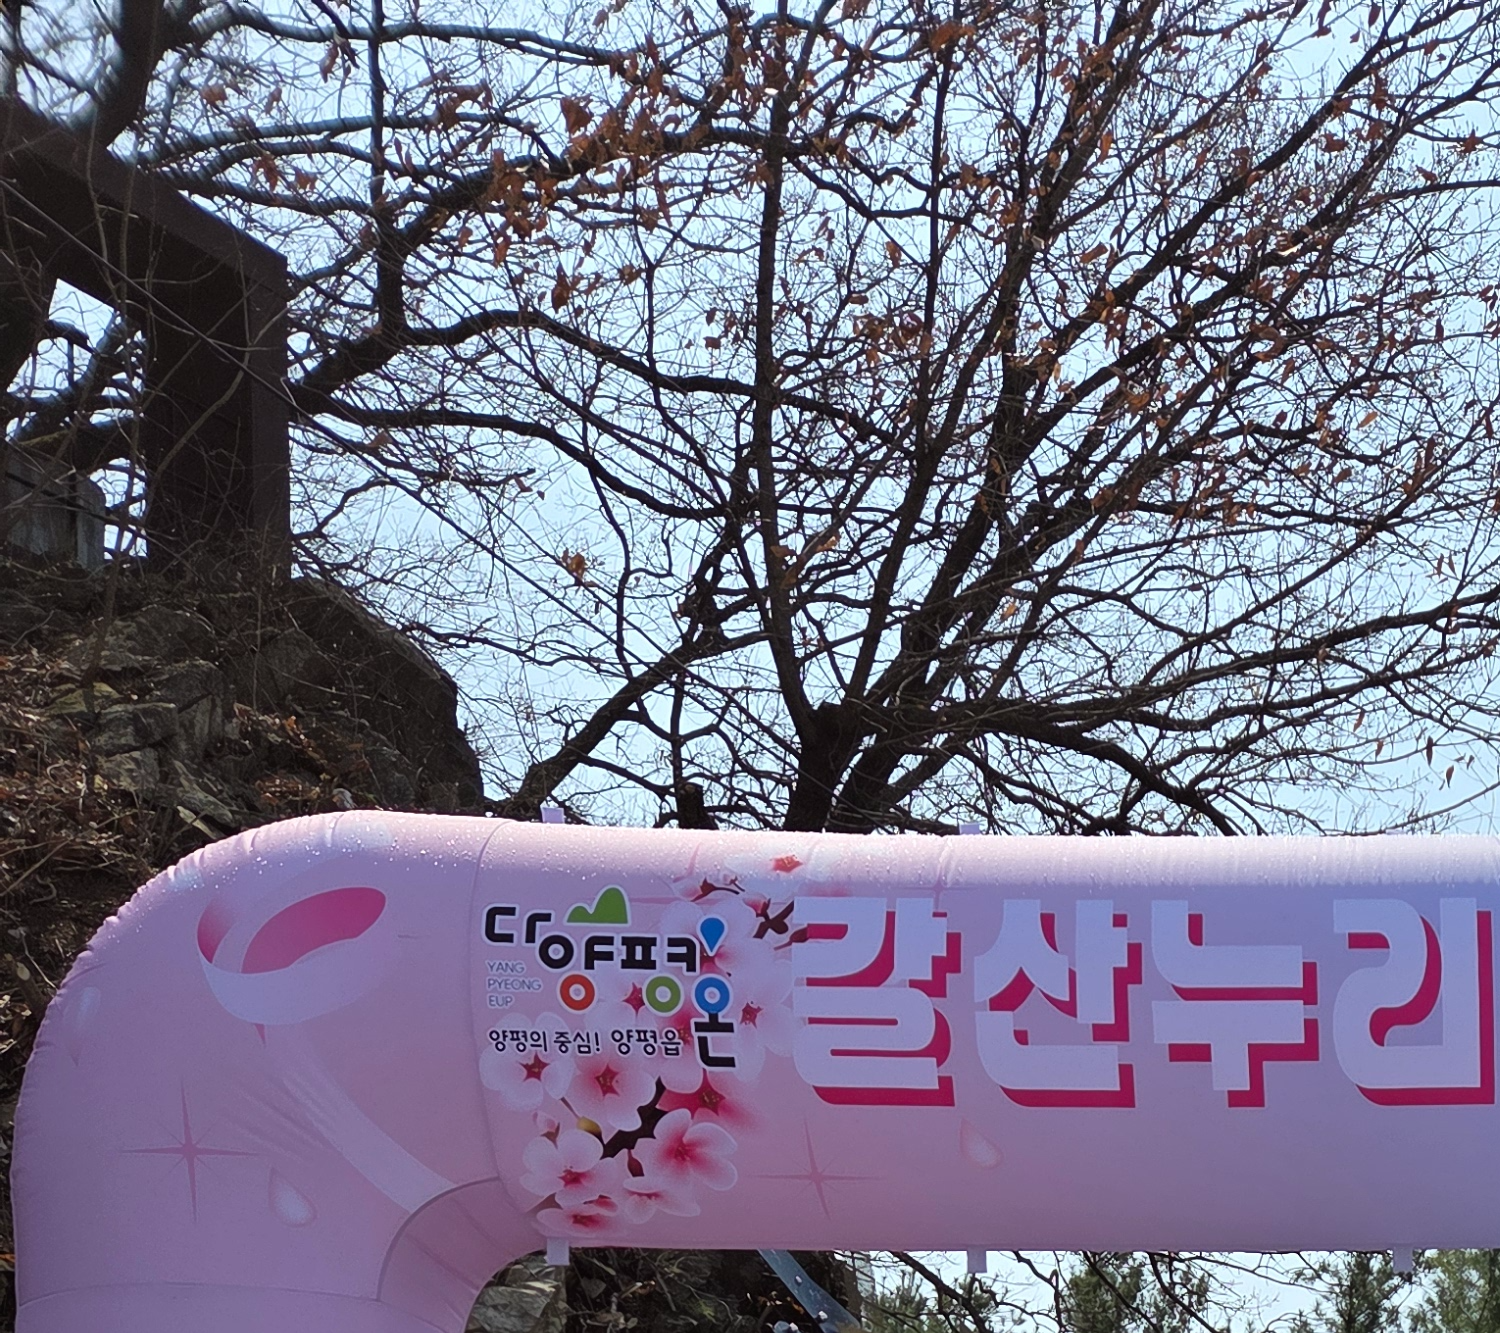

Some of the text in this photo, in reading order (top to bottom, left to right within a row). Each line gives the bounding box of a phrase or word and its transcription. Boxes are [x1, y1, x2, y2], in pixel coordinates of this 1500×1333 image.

[487, 961, 525, 974] YANG
[487, 978, 542, 991] PYEONG
[487, 996, 514, 1008] EUP
[488, 1028, 682, 1057] 양평의 중심! 양평읍
